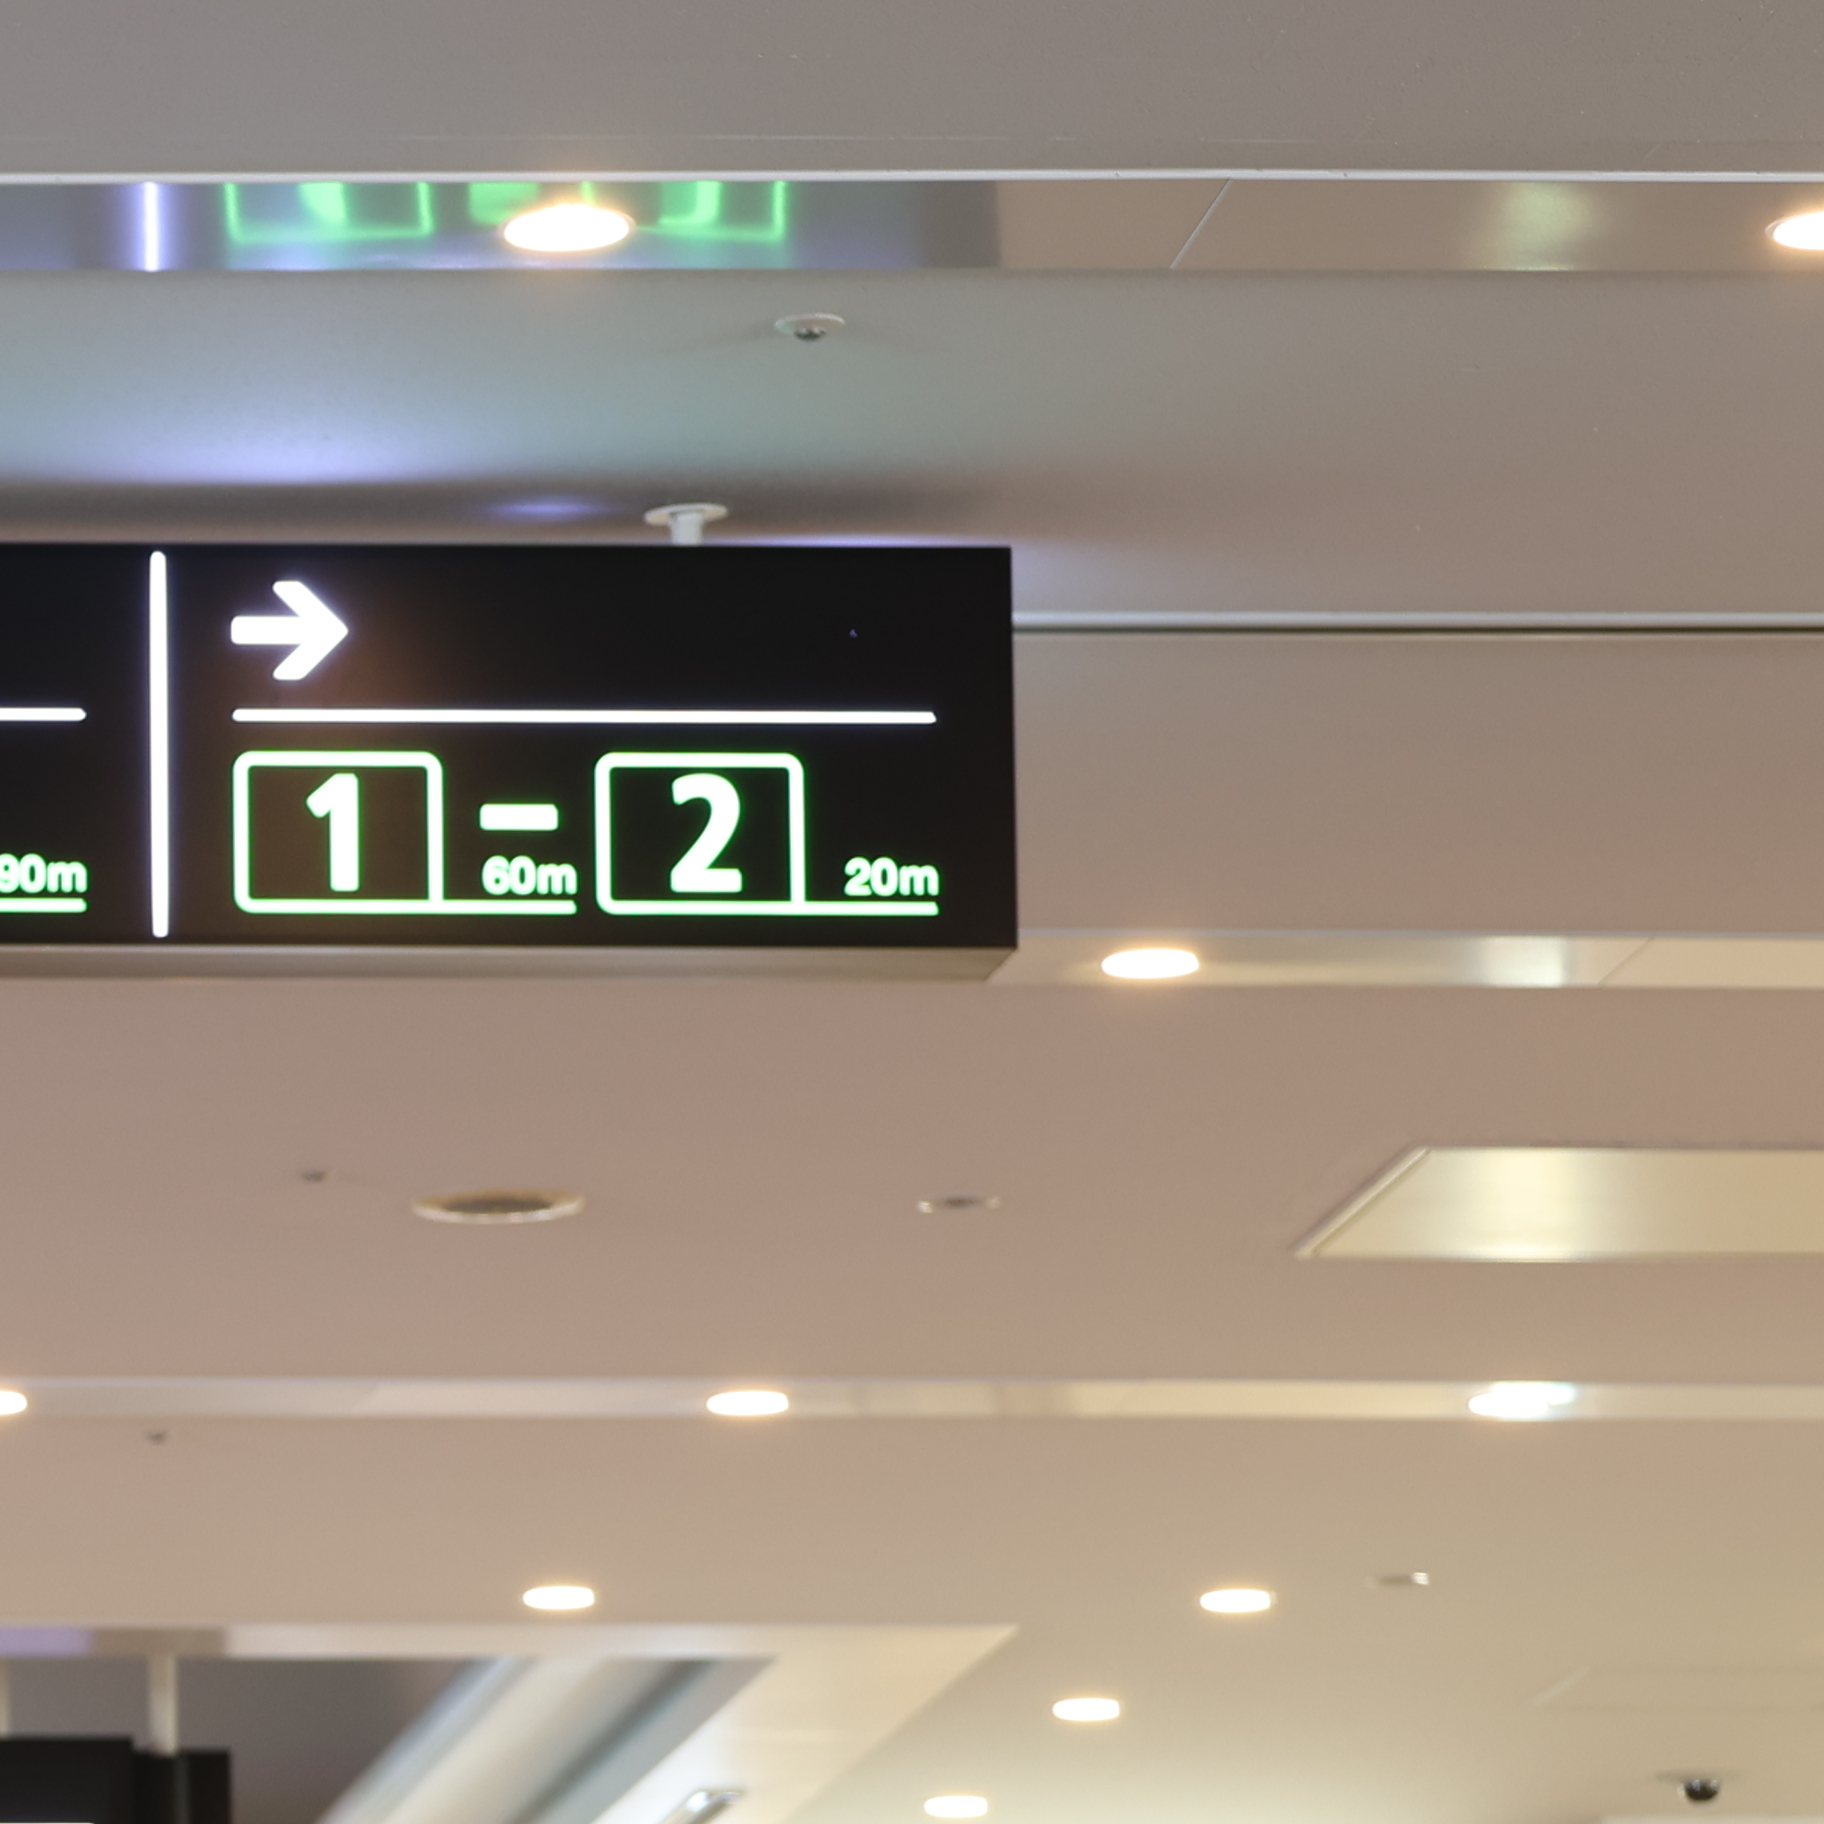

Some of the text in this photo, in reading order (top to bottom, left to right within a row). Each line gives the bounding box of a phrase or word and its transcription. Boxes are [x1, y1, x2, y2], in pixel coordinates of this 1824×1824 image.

[306, 772, 360, 891] 1
[671, 773, 743, 893] 2
[482, 856, 577, 895] 60m
[845, 857, 939, 896] 20m
